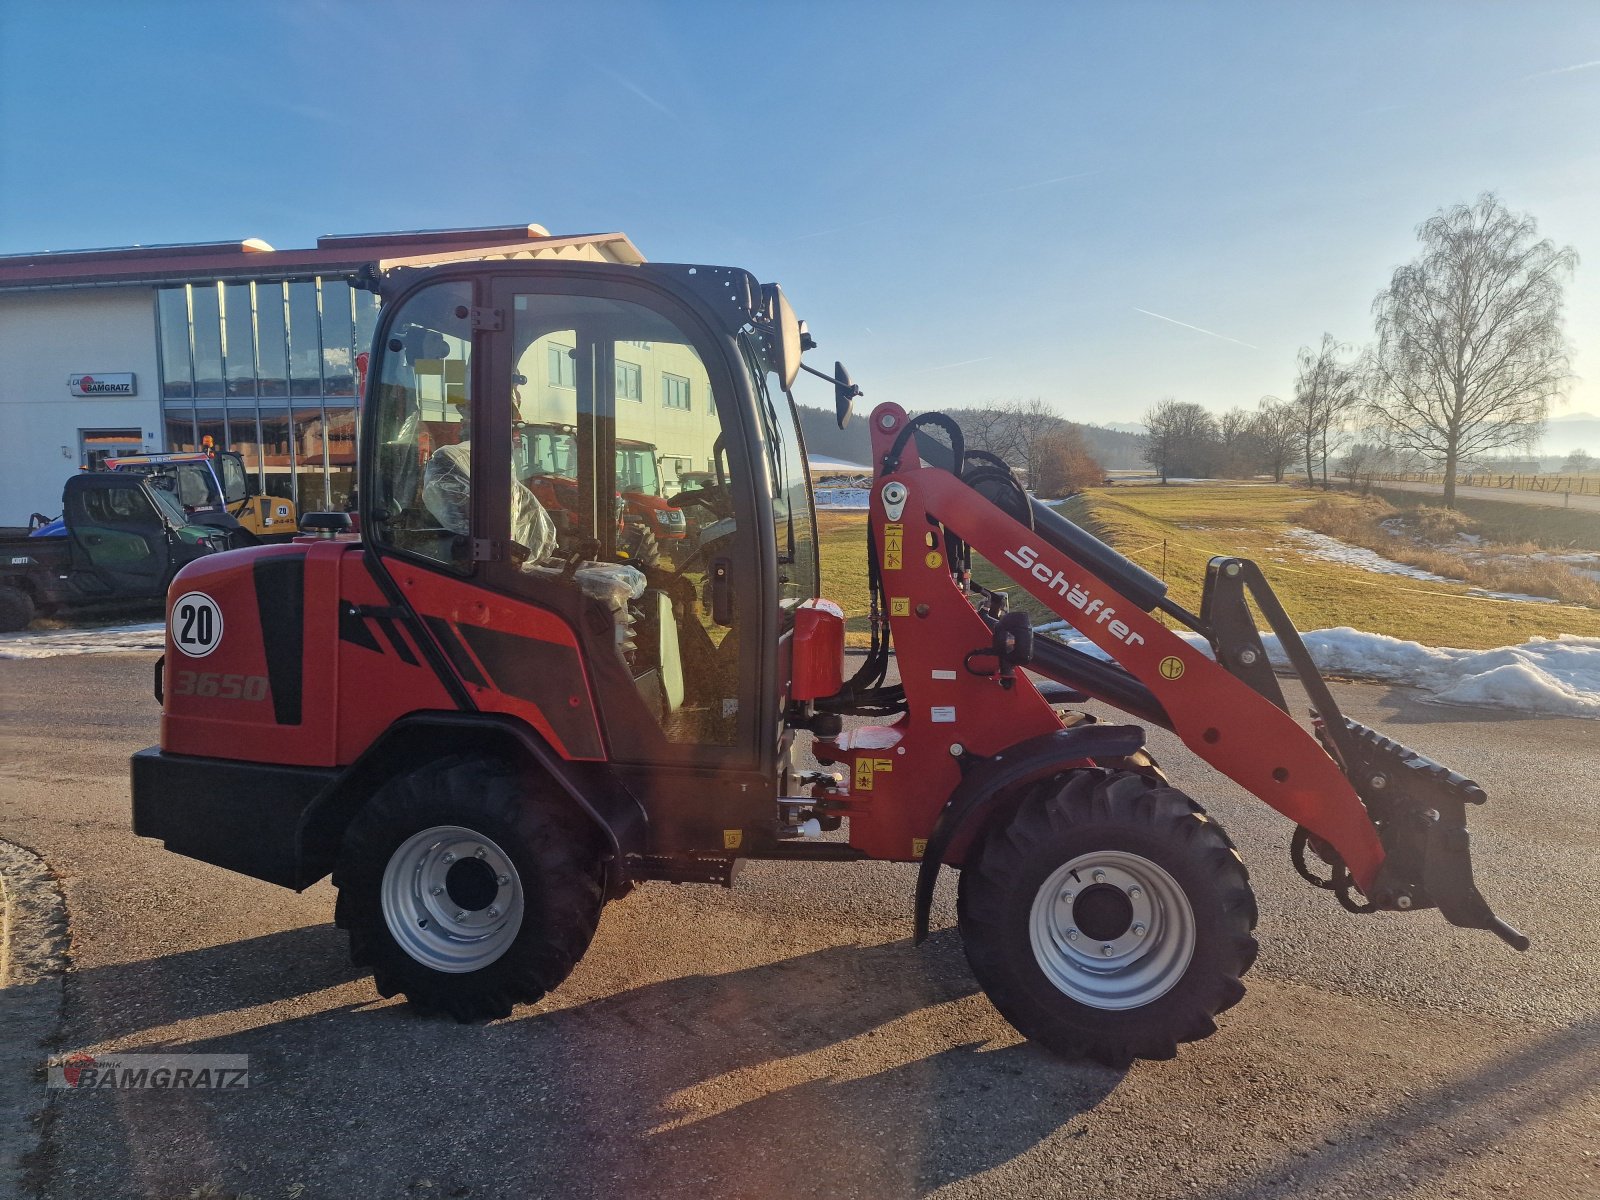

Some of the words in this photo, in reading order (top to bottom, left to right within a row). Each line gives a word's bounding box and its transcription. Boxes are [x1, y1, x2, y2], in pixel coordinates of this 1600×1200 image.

[87, 384, 130, 392] BAMGRATZ
[278, 507, 287, 515] 20
[1004, 545, 1145, 646] Schäffer
[180, 604, 213, 646] 20
[174, 670, 269, 702] 3650
